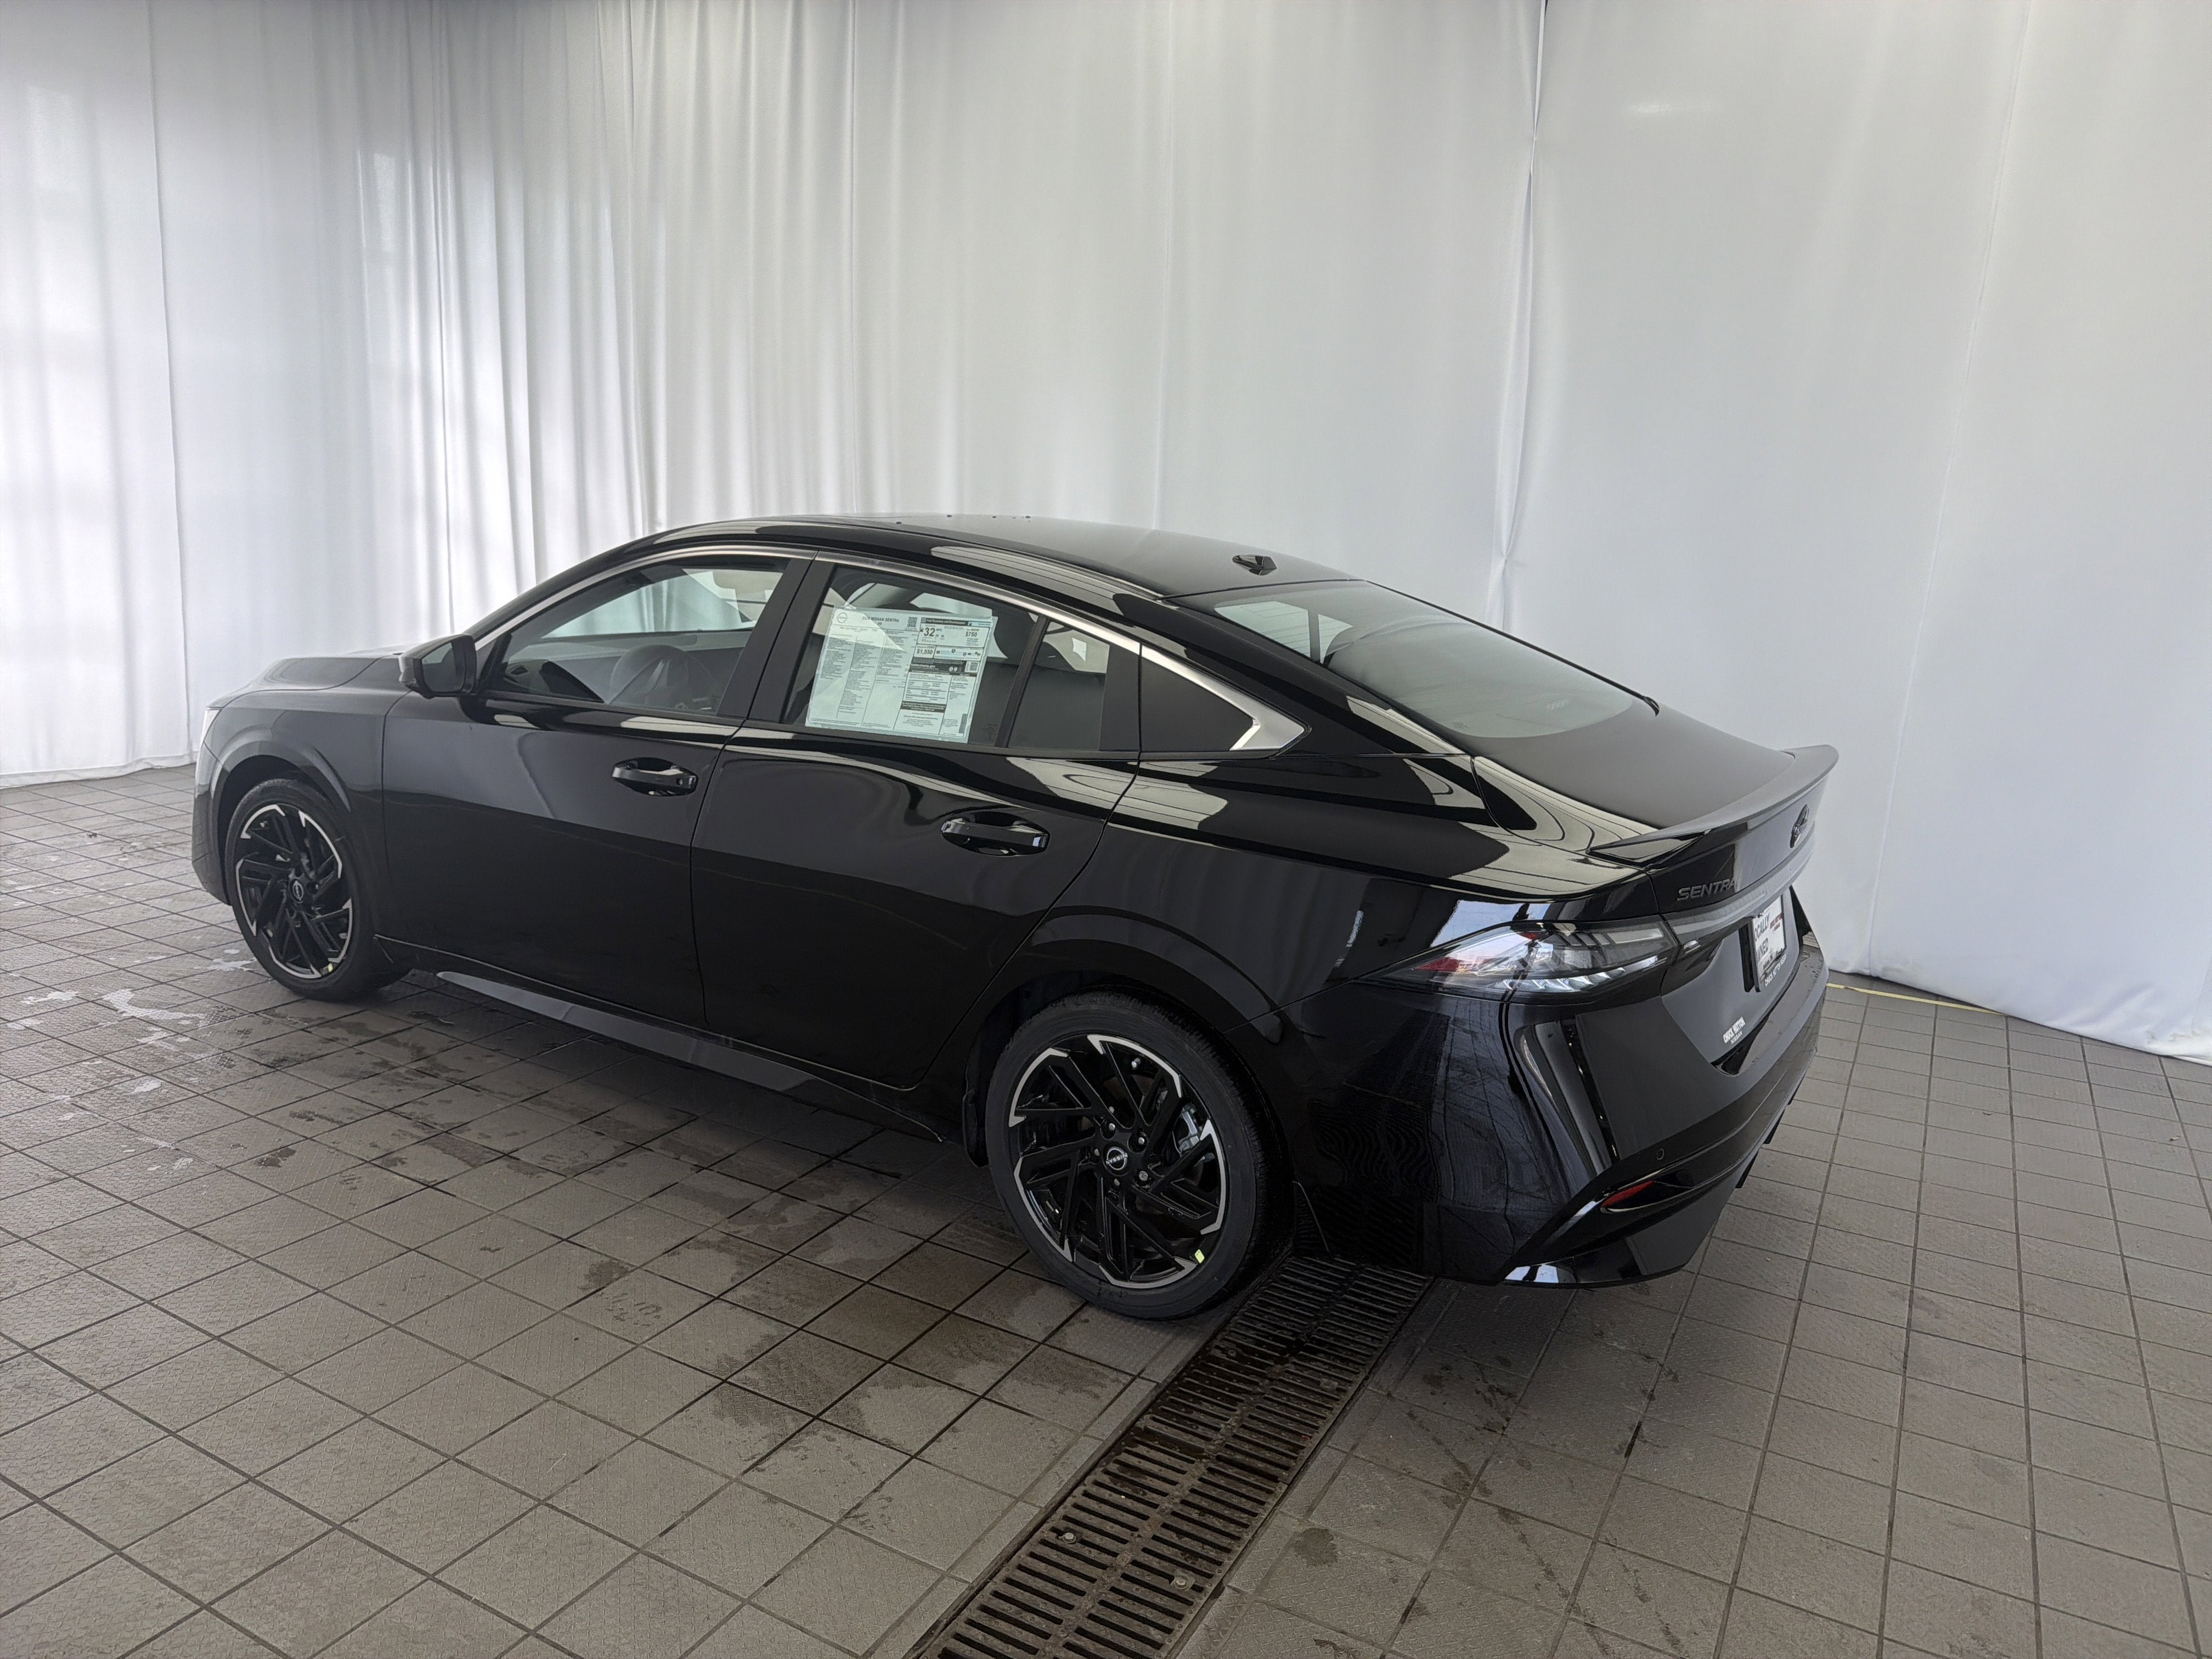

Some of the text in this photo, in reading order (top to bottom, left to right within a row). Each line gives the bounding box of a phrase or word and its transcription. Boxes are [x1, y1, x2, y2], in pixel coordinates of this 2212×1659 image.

[923, 627, 935, 637] 32
[1677, 877, 1737, 901] SENTRA
[1755, 913, 1770, 942] OCALLY
[1106, 1153, 1128, 1165] NISSAN
